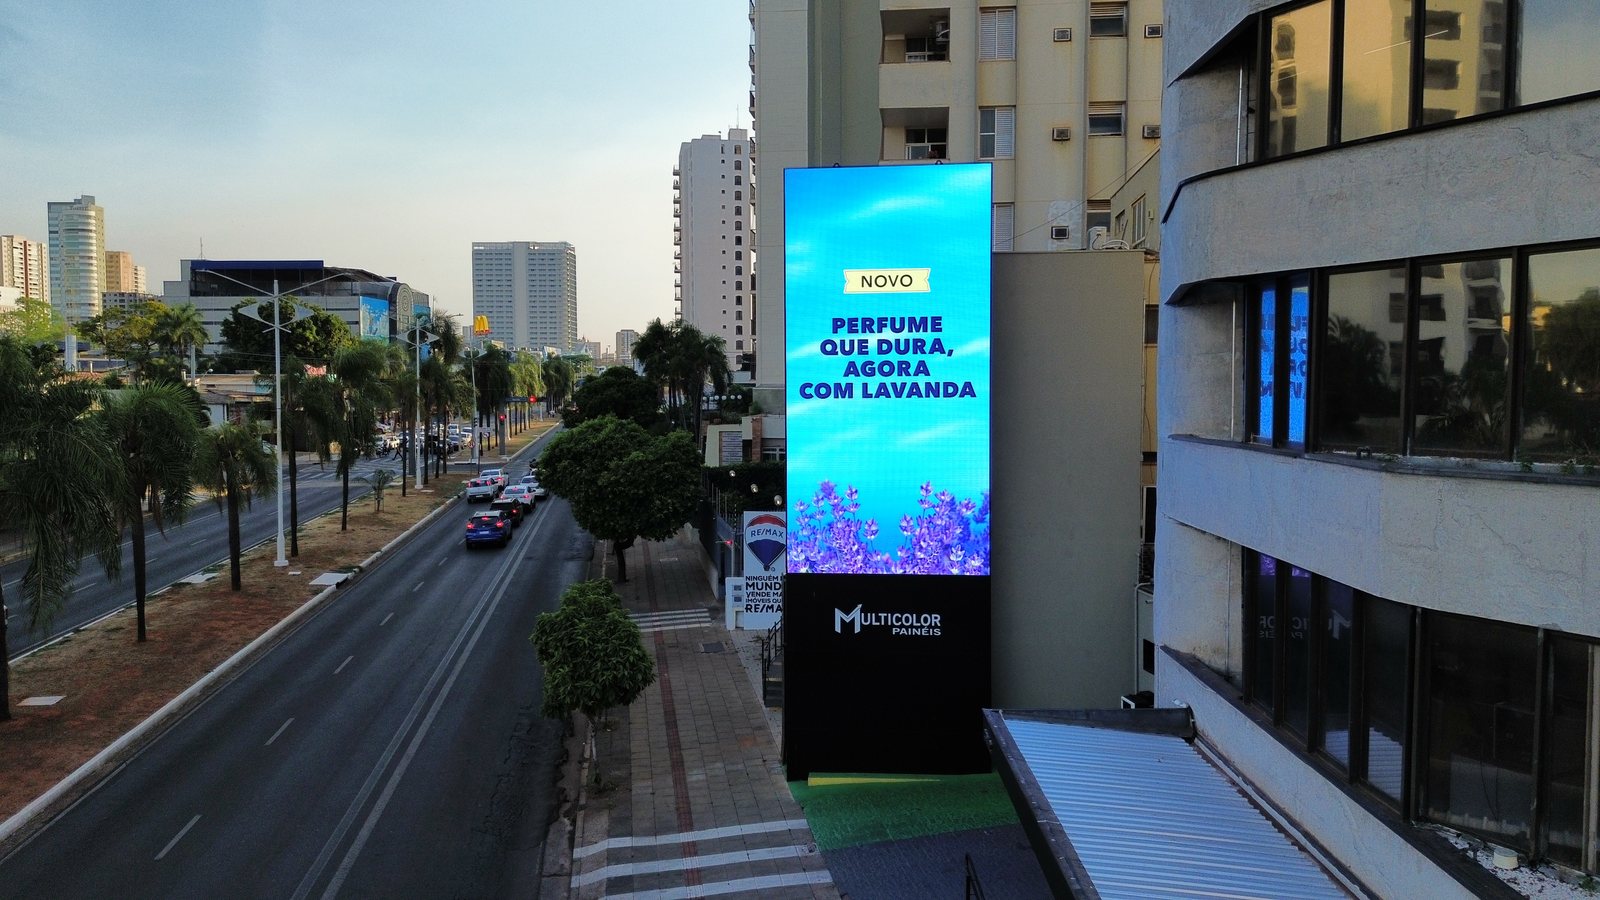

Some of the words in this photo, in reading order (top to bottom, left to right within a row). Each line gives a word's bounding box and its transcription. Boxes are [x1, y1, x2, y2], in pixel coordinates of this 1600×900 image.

[861, 274, 913, 288] NOVO
[832, 316, 943, 334] PERFUME
[820, 339, 869, 356] QUE
[877, 338, 954, 357] DURA,
[843, 360, 931, 377] AGORA
[799, 382, 854, 399] COM
[861, 381, 977, 398] LAVANDA
[750, 528, 784, 538] RE/MAX
[745, 582, 782, 591] MUND
[745, 604, 783, 613] RE/MA
[834, 604, 941, 634] MULTICOLOR
[892, 626, 942, 636] PAINÉIS
